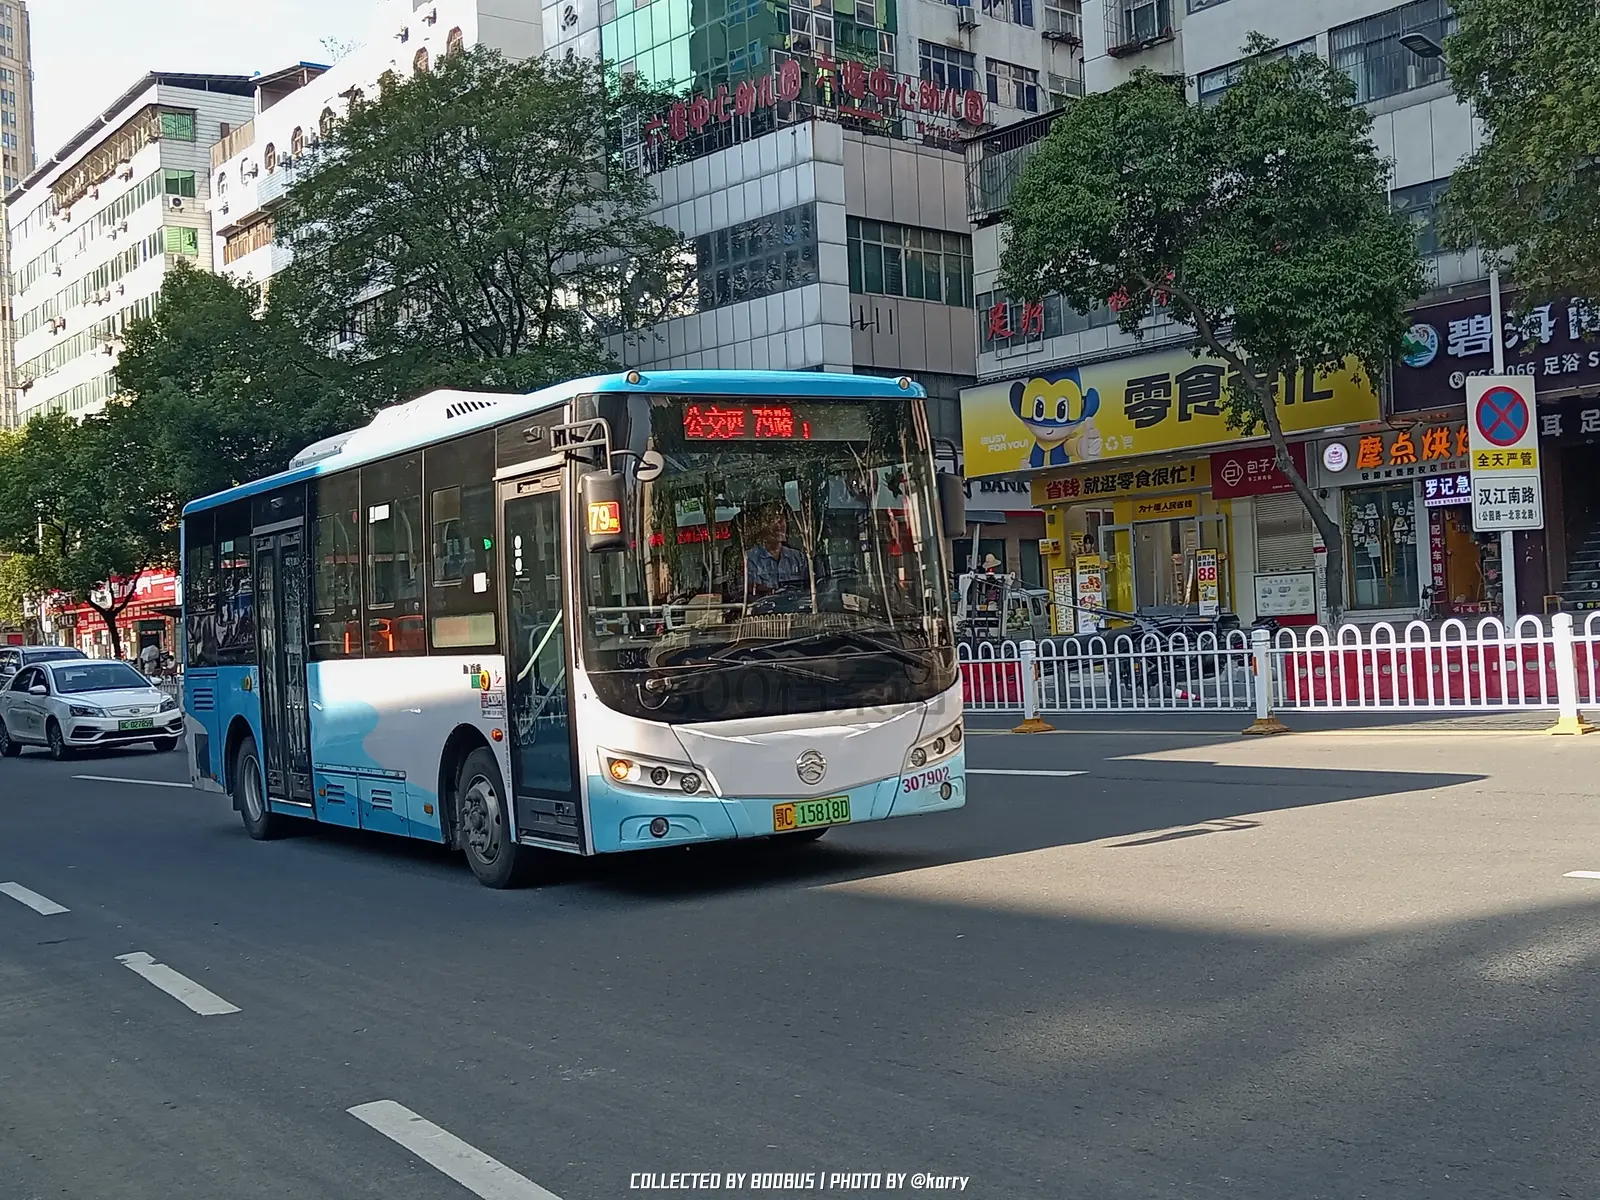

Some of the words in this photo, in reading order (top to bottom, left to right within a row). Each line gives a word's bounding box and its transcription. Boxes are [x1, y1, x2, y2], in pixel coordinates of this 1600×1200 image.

[1543, 353, 1580, 375] 足浴
[1477, 452, 1532, 467] 全天严管
[1046, 478, 1081, 499] 省钱
[1425, 475, 1471, 498] 罗记急
[1478, 486, 1535, 505] 汉江南路
[1430, 524, 1443, 586] 配汽车钥匙
[902, 766, 951, 793] 307902
[800, 800, 849, 825] 15818D
